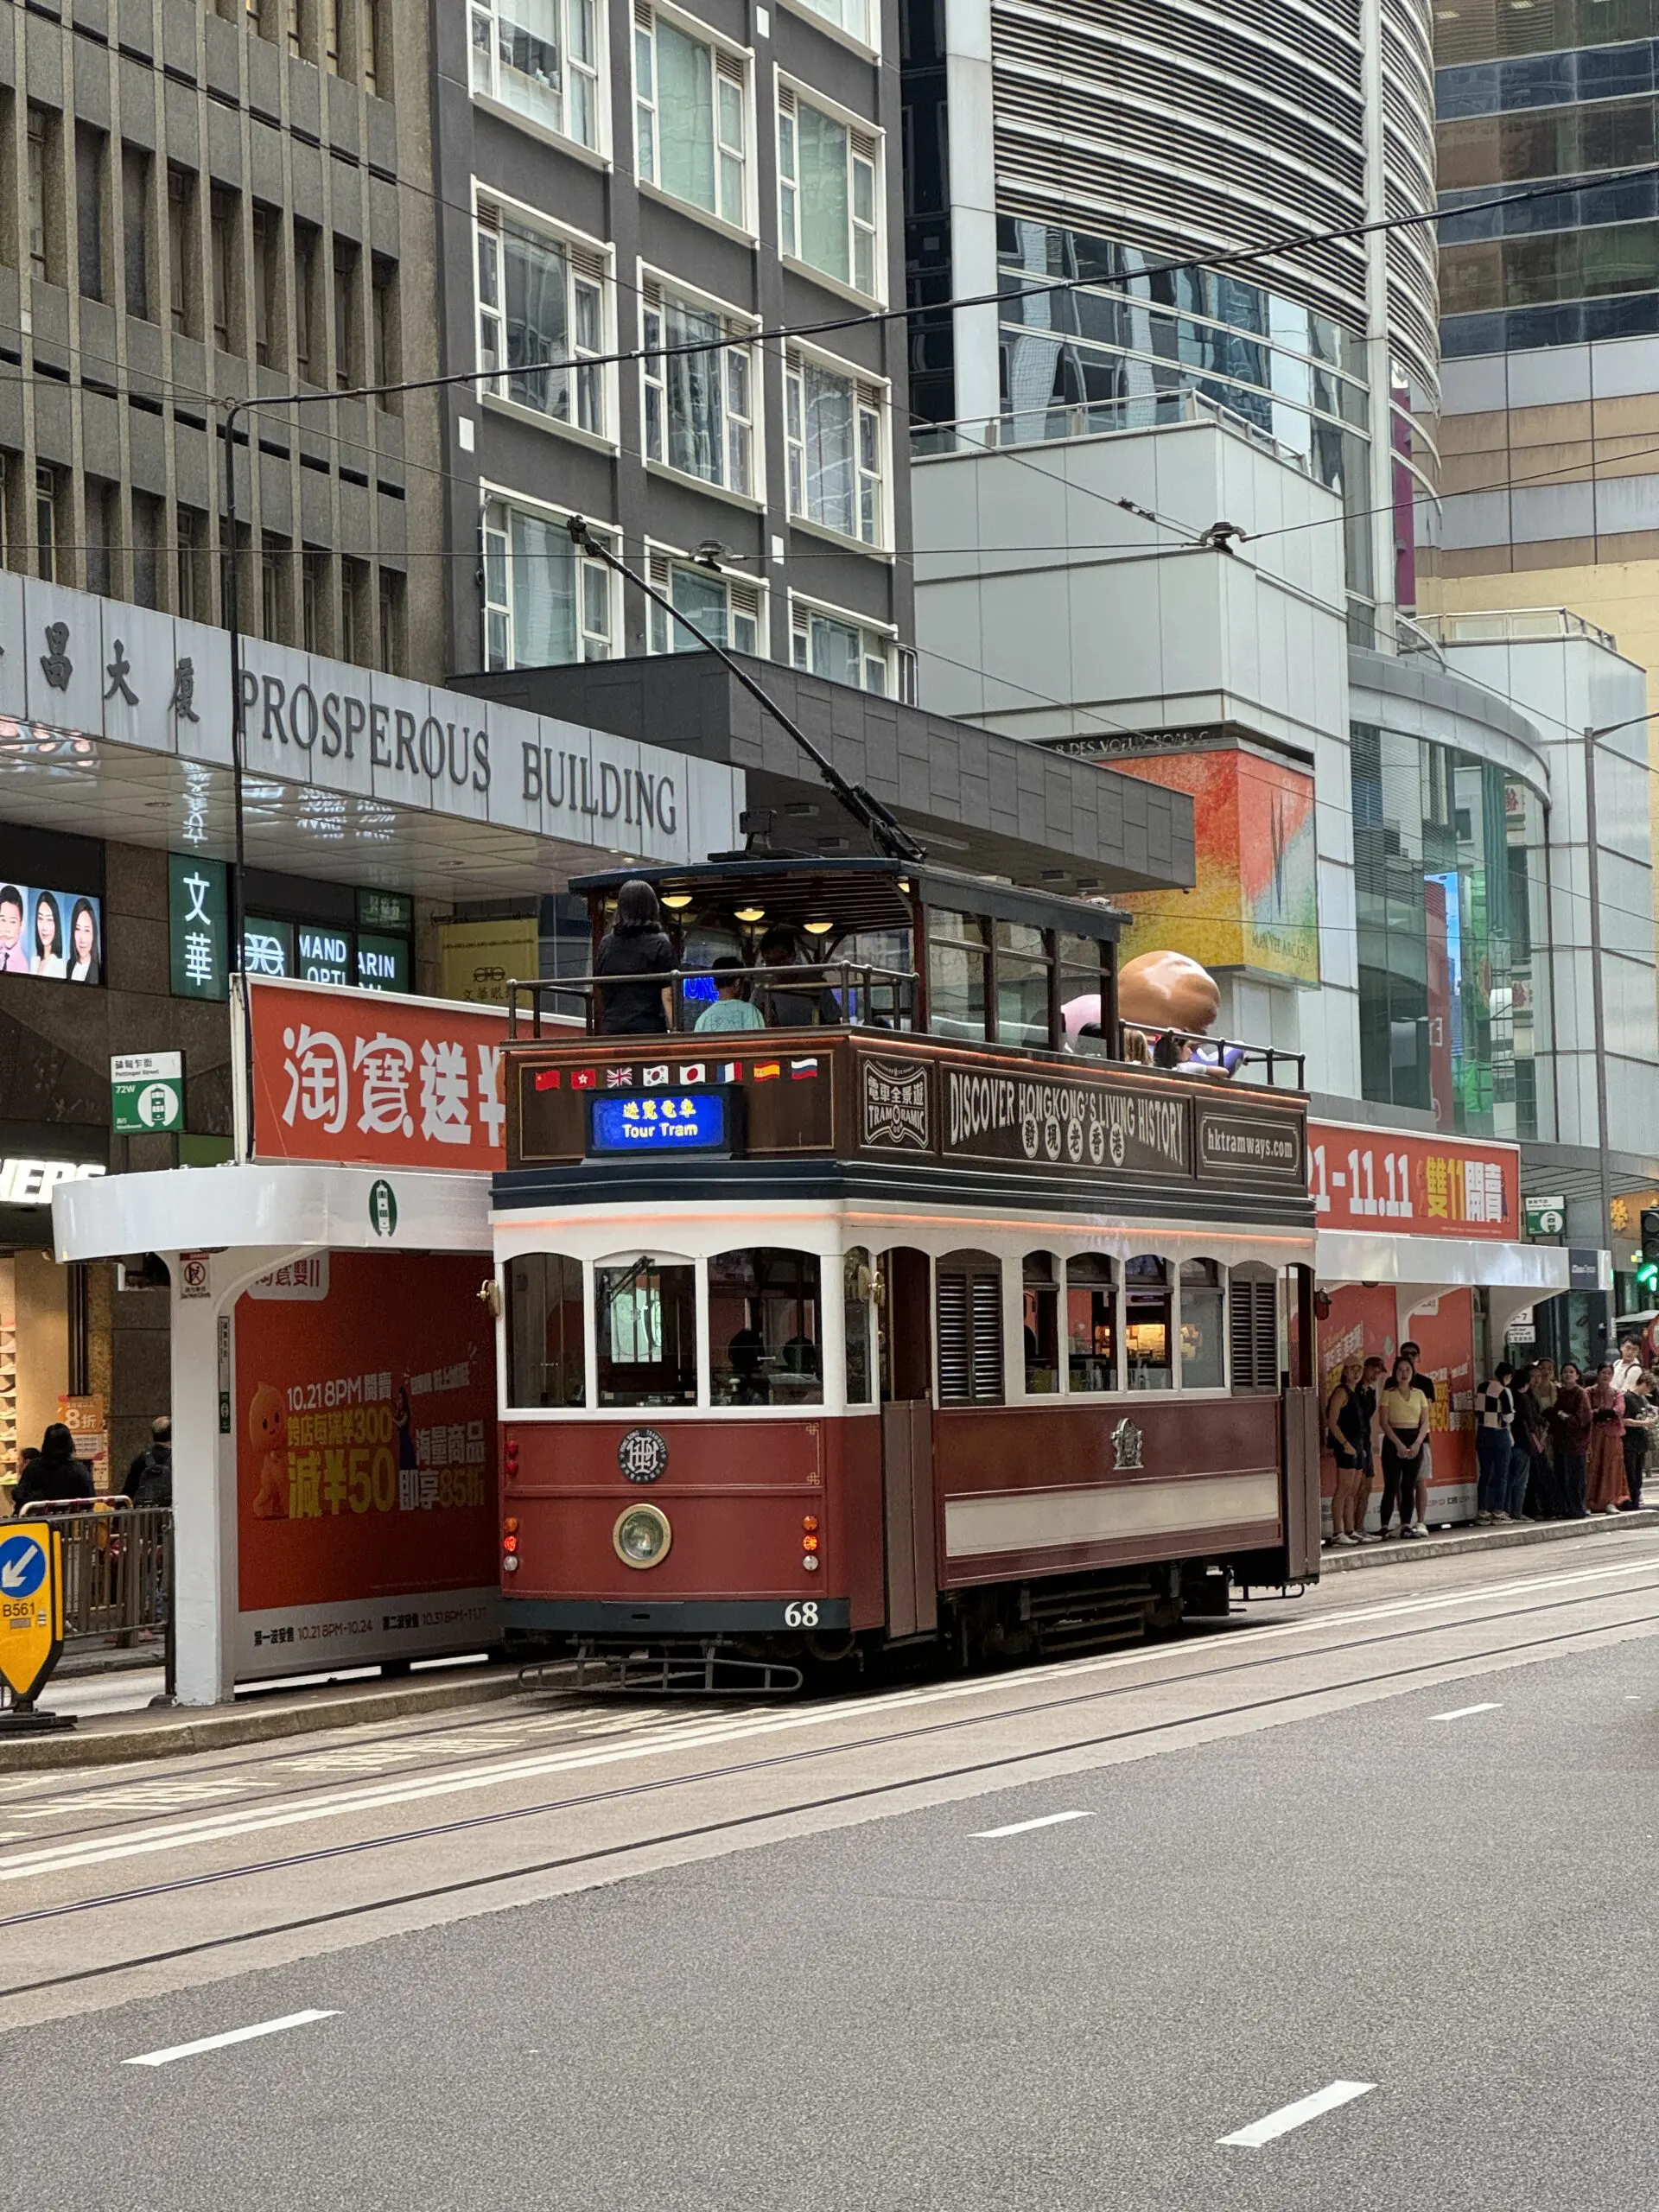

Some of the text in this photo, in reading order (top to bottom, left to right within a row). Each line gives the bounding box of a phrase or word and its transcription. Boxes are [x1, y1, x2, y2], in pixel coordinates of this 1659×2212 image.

[0, 621, 200, 723] 昌大廈
[238, 670, 492, 791] PROSPEROUS
[522, 741, 677, 835] BUILDING
[182, 871, 213, 986] 文華
[464, 986, 518, 1001] 文華眼
[115, 1084, 136, 1094] 72W
[868, 1075, 924, 1106] 電車全景遊
[622, 1098, 696, 1120] 遊覽電車
[868, 1104, 925, 1135] TRAMORAMIC
[950, 1072, 1014, 1146] DISCOVER
[1099, 1093, 1135, 1137] LIVING
[1137, 1098, 1183, 1166] HISTORY
[622, 1122, 698, 1139] Tour Tram
[1025, 1119, 1122, 1158] 發現老香港
[1208, 1128, 1293, 1160] hktramways.com
[1307, 1145, 1413, 1218] 1-11.11
[287, 1382, 322, 1411] 10.21
[324, 1376, 362, 1408] 8PM
[399, 1465, 486, 1511] 即享85折
[3, 1602, 35, 1618] B561
[785, 1601, 818, 1628] 68
